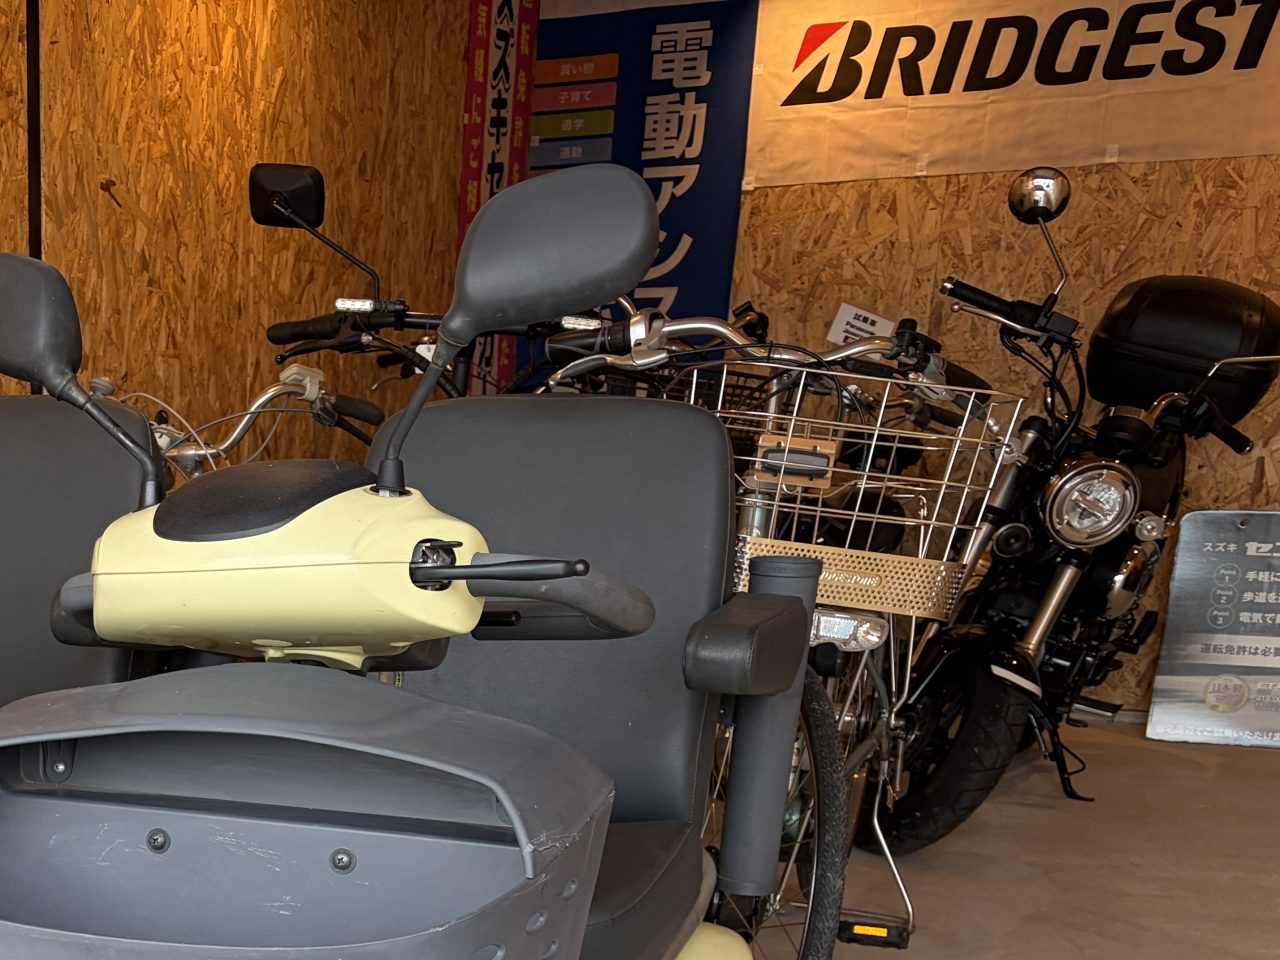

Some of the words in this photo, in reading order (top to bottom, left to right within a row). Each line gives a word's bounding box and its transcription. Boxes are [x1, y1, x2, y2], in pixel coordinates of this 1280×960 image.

[780, 0, 1280, 107] BRIDGEST
[560, 62, 595, 76] 買い物
[558, 90, 593, 104] 子育て
[465, 4, 488, 232] 気軽にご相
[1203, 542, 1238, 553] スズキ
[1245, 571, 1280, 582] 手軽に
[1242, 592, 1280, 603] 歩道を
[1239, 612, 1280, 624] 電気で
[1199, 643, 1280, 658] 運転免許は必要
